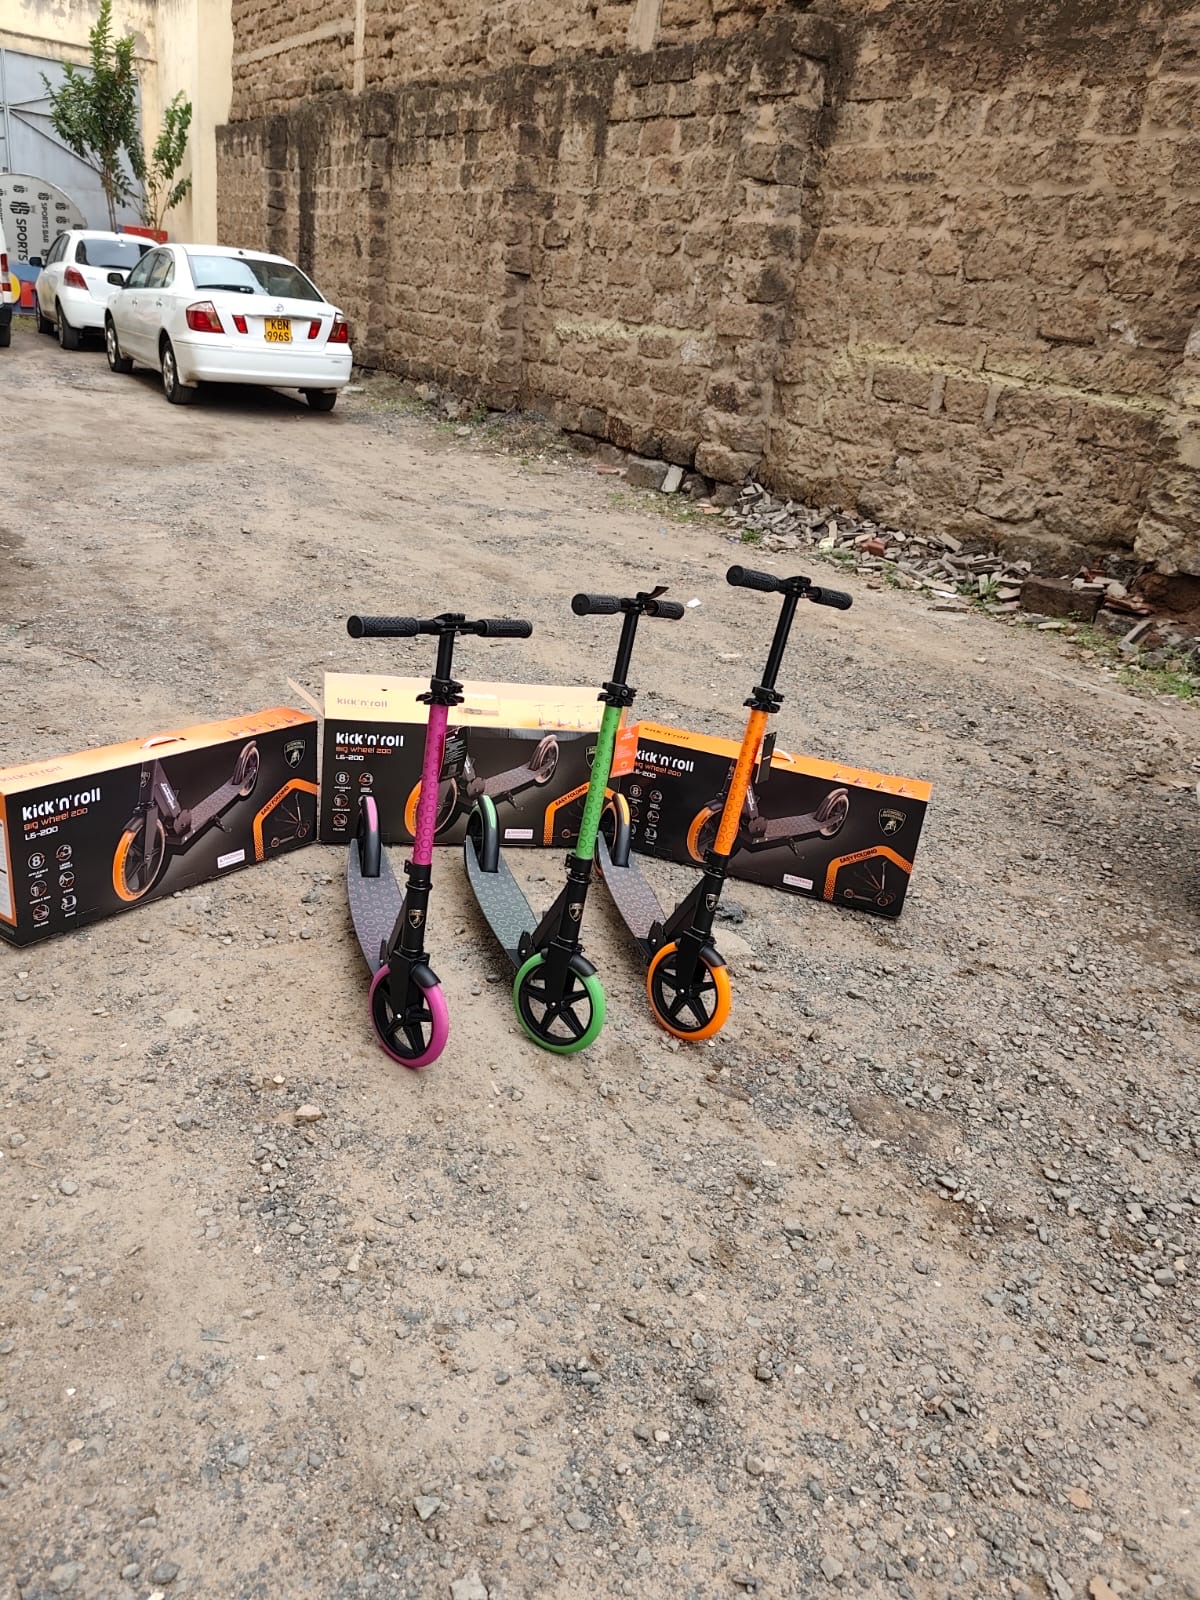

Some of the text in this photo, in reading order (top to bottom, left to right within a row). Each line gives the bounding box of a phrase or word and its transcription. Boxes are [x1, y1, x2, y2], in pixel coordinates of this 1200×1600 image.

[41, 202, 49, 228] SPORTS
[16, 218, 28, 262] SPORTS
[271, 320, 289, 330] KBN
[267, 331, 290, 342] 996S
[645, 763, 667, 774] wheel
[339, 773, 346, 783] 8
[41, 812, 69, 826] wheel
[70, 807, 88, 818] 200
[32, 856, 41, 867] 8
